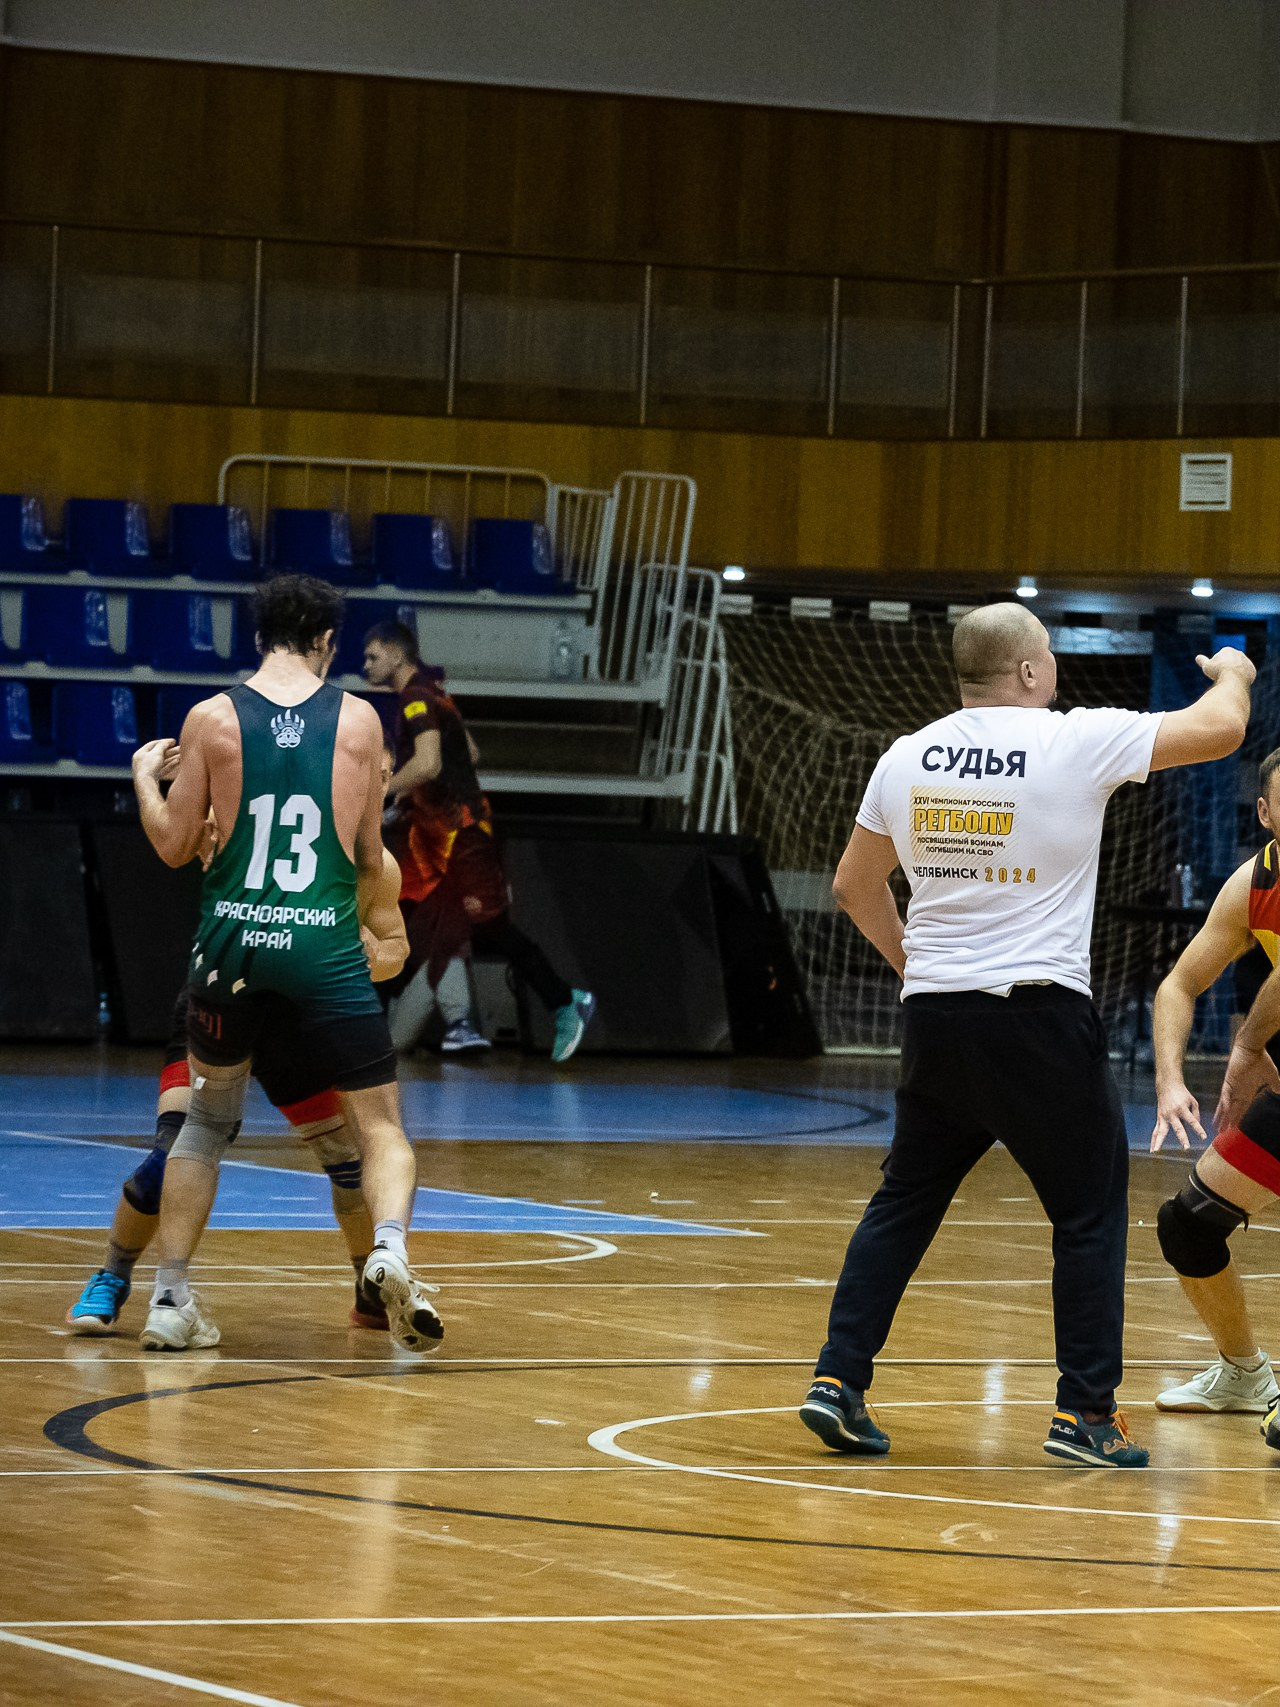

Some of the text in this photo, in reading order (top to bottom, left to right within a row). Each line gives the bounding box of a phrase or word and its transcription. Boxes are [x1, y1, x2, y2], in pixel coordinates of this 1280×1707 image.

[921, 745, 1026, 779] СУДЬЯ
[914, 797, 929, 805] XXVI
[930, 798, 971, 806] ЧЕМПИОНАТ
[972, 800, 1002, 808] РОССИИ
[914, 809, 1014, 835] РЕГБОЛУ
[244, 794, 321, 892] 13
[917, 837, 1006, 849] ПОСВЯЩЕННЫЙ ВОИНАМ,
[926, 846, 964, 854] ПОГИБШИМ
[913, 866, 1036, 883] ЧЕЛЯБИНСК 2024
[214, 900, 336, 927] КРАСНОЯРСКИЙ
[241, 929, 293, 950] КРАЙ
